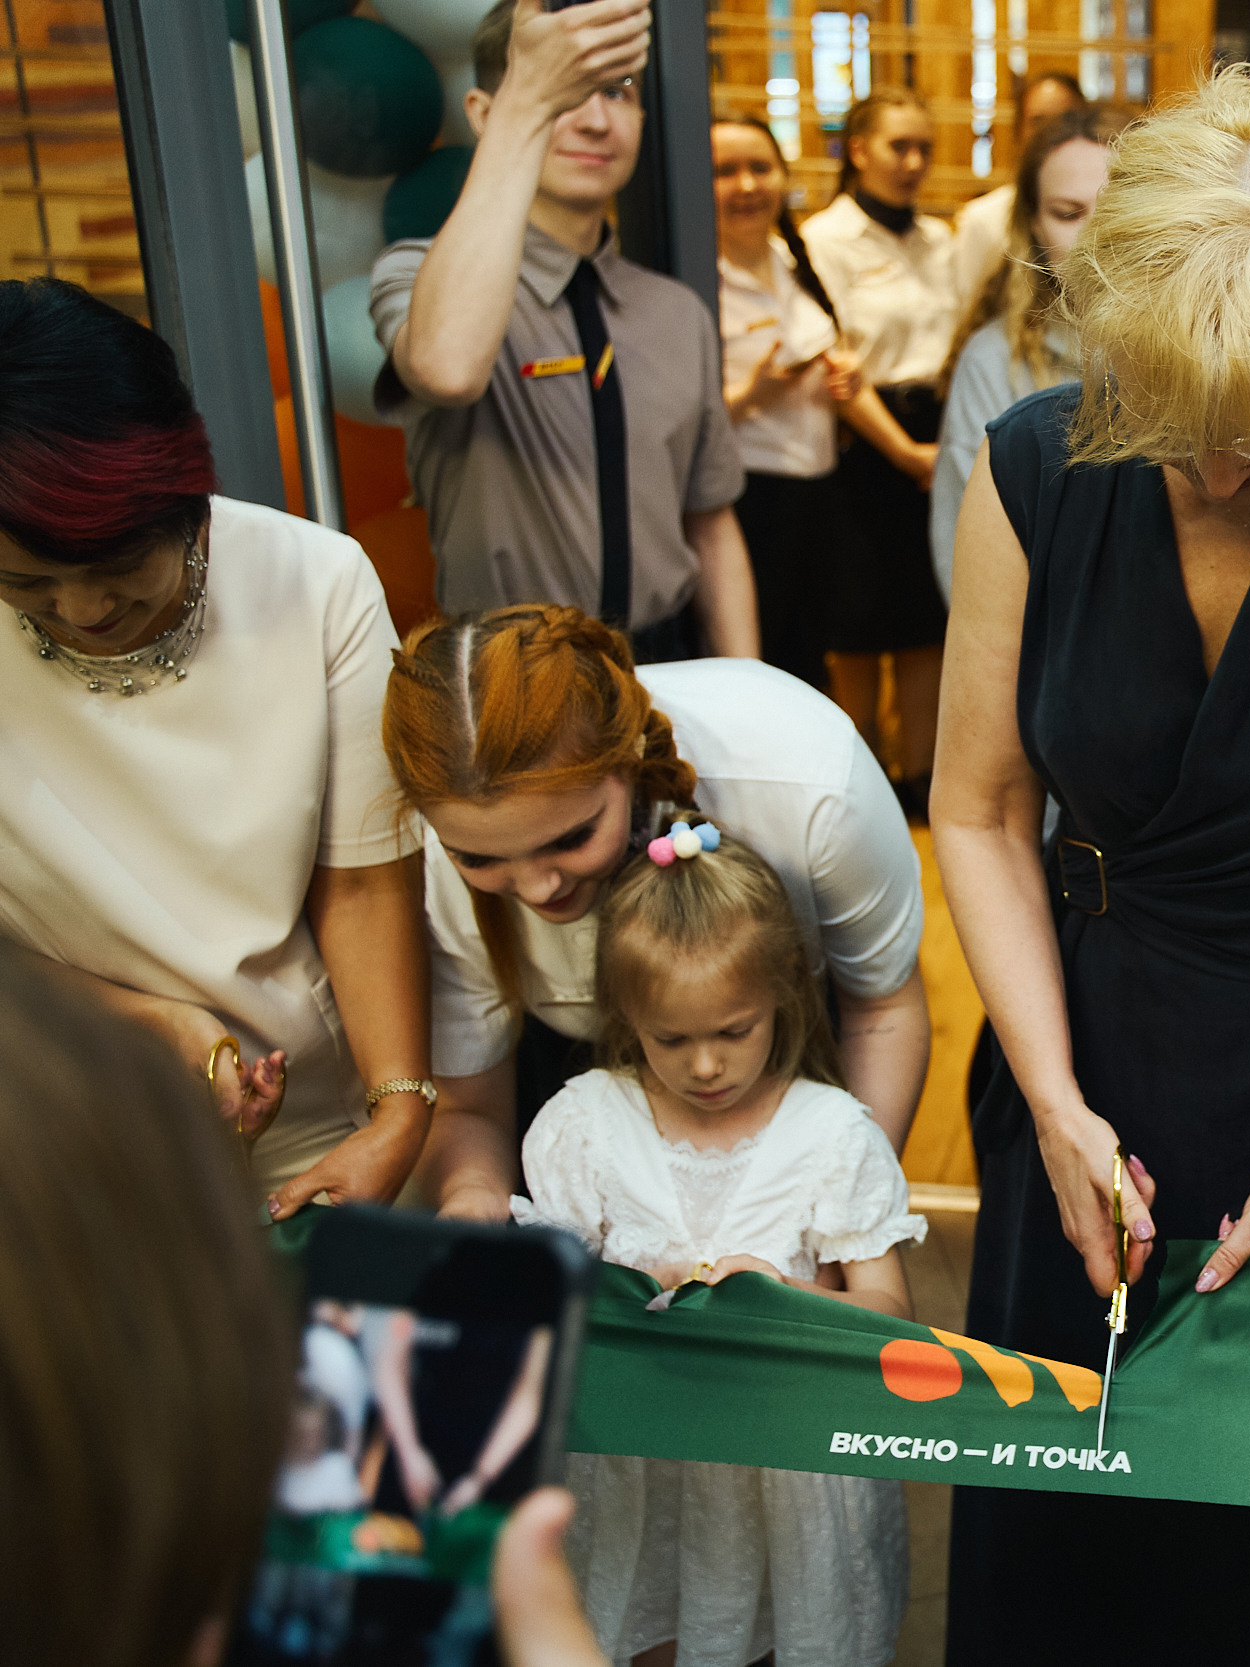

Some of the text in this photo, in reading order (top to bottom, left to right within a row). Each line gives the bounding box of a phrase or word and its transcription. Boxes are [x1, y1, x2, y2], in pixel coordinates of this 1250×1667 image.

[829, 1431, 958, 1463] ВКУСНО
[991, 1443, 1016, 1466] И
[1024, 1445, 1132, 1474] ТОЧКА
